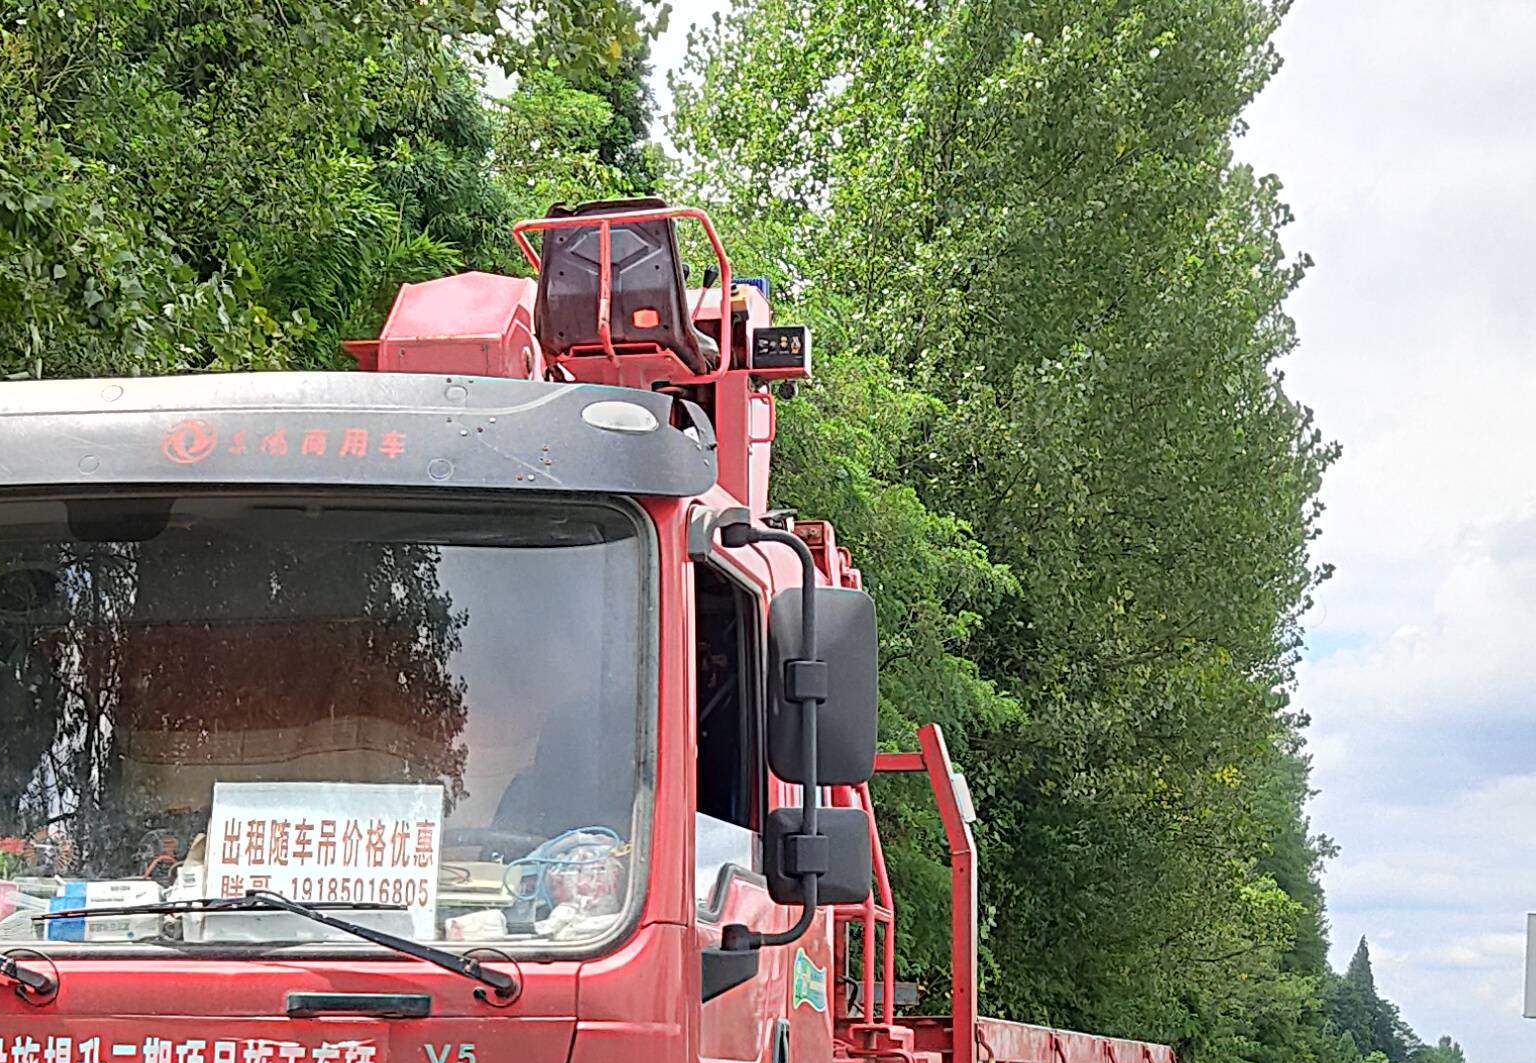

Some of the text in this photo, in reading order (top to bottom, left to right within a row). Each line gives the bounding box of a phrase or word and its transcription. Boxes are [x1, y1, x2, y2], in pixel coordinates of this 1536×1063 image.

[221, 817, 436, 868] 出租随车吊价格优惠
